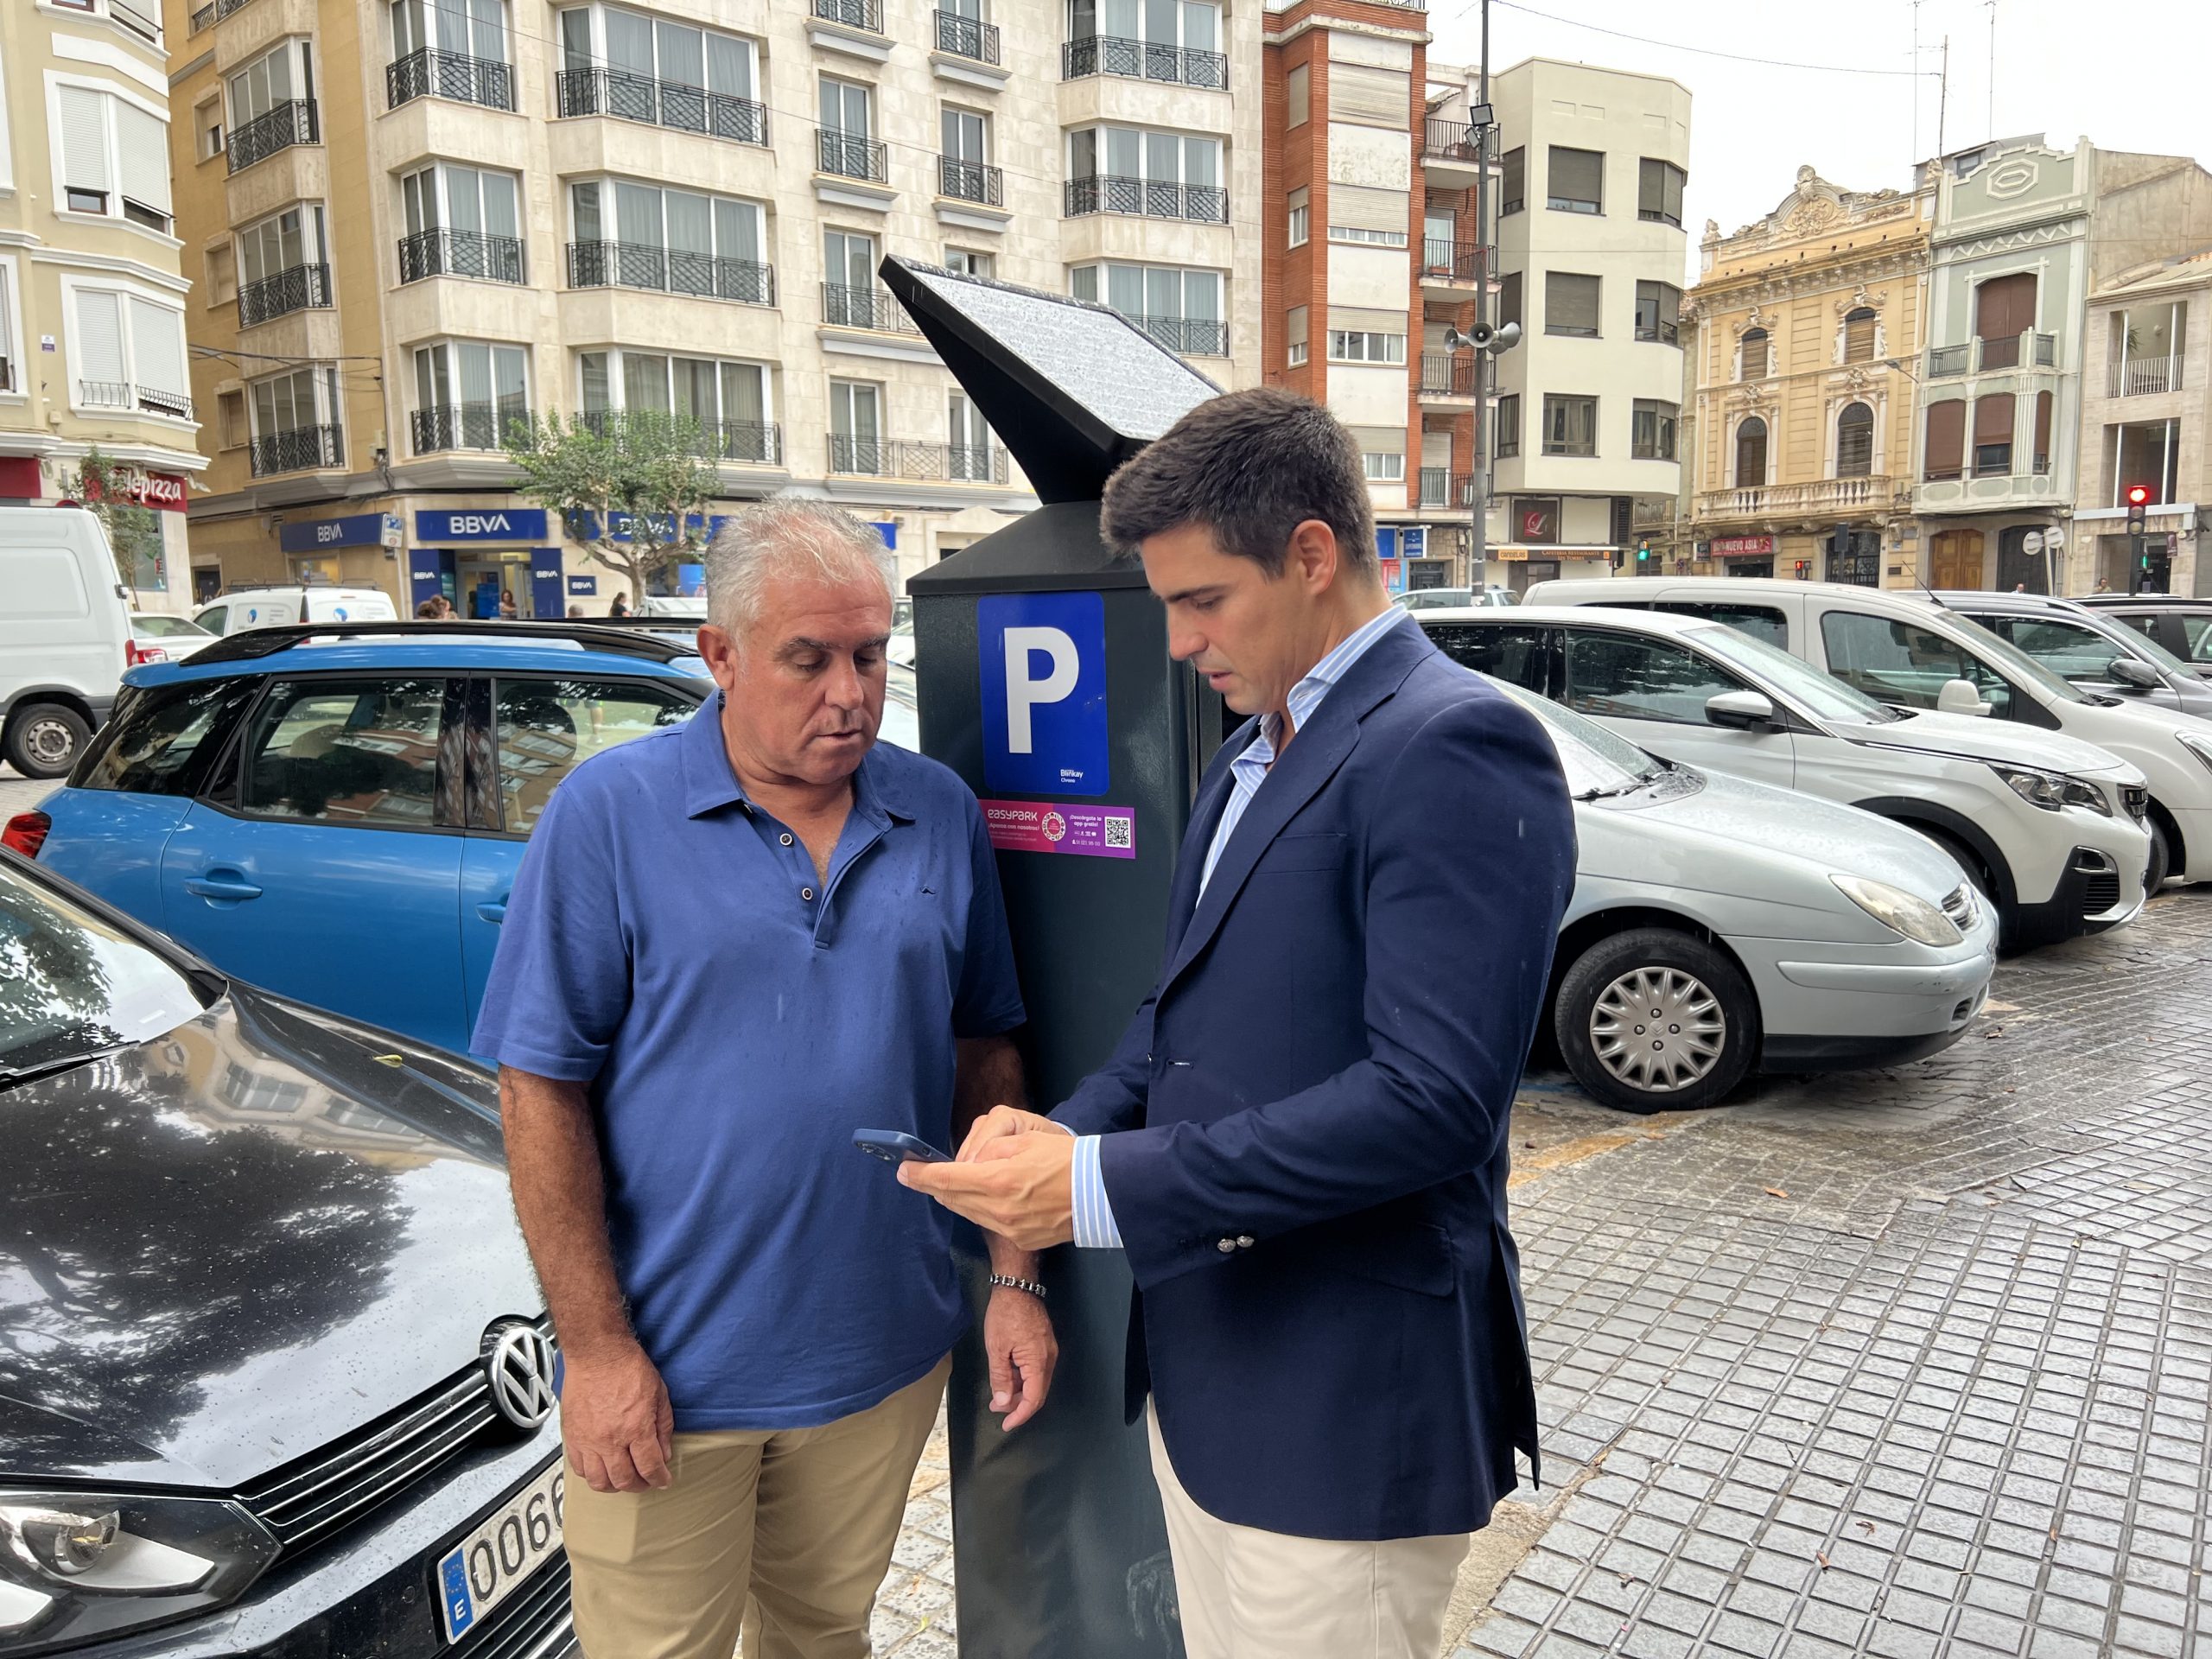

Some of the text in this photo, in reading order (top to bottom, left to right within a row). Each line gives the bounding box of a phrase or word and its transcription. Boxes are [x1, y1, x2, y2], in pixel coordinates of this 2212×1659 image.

[317, 522, 343, 543] BBVA
[449, 513, 512, 535] BBVA
[1726, 540, 1744, 552] NUEVO
[1745, 539, 1758, 550] ASIA
[414, 571, 435, 580] BBVA
[536, 570, 558, 579] BBVA
[571, 581, 593, 590] BBVA
[1003, 626, 1080, 754] P
[454, 1598, 467, 1621] E
